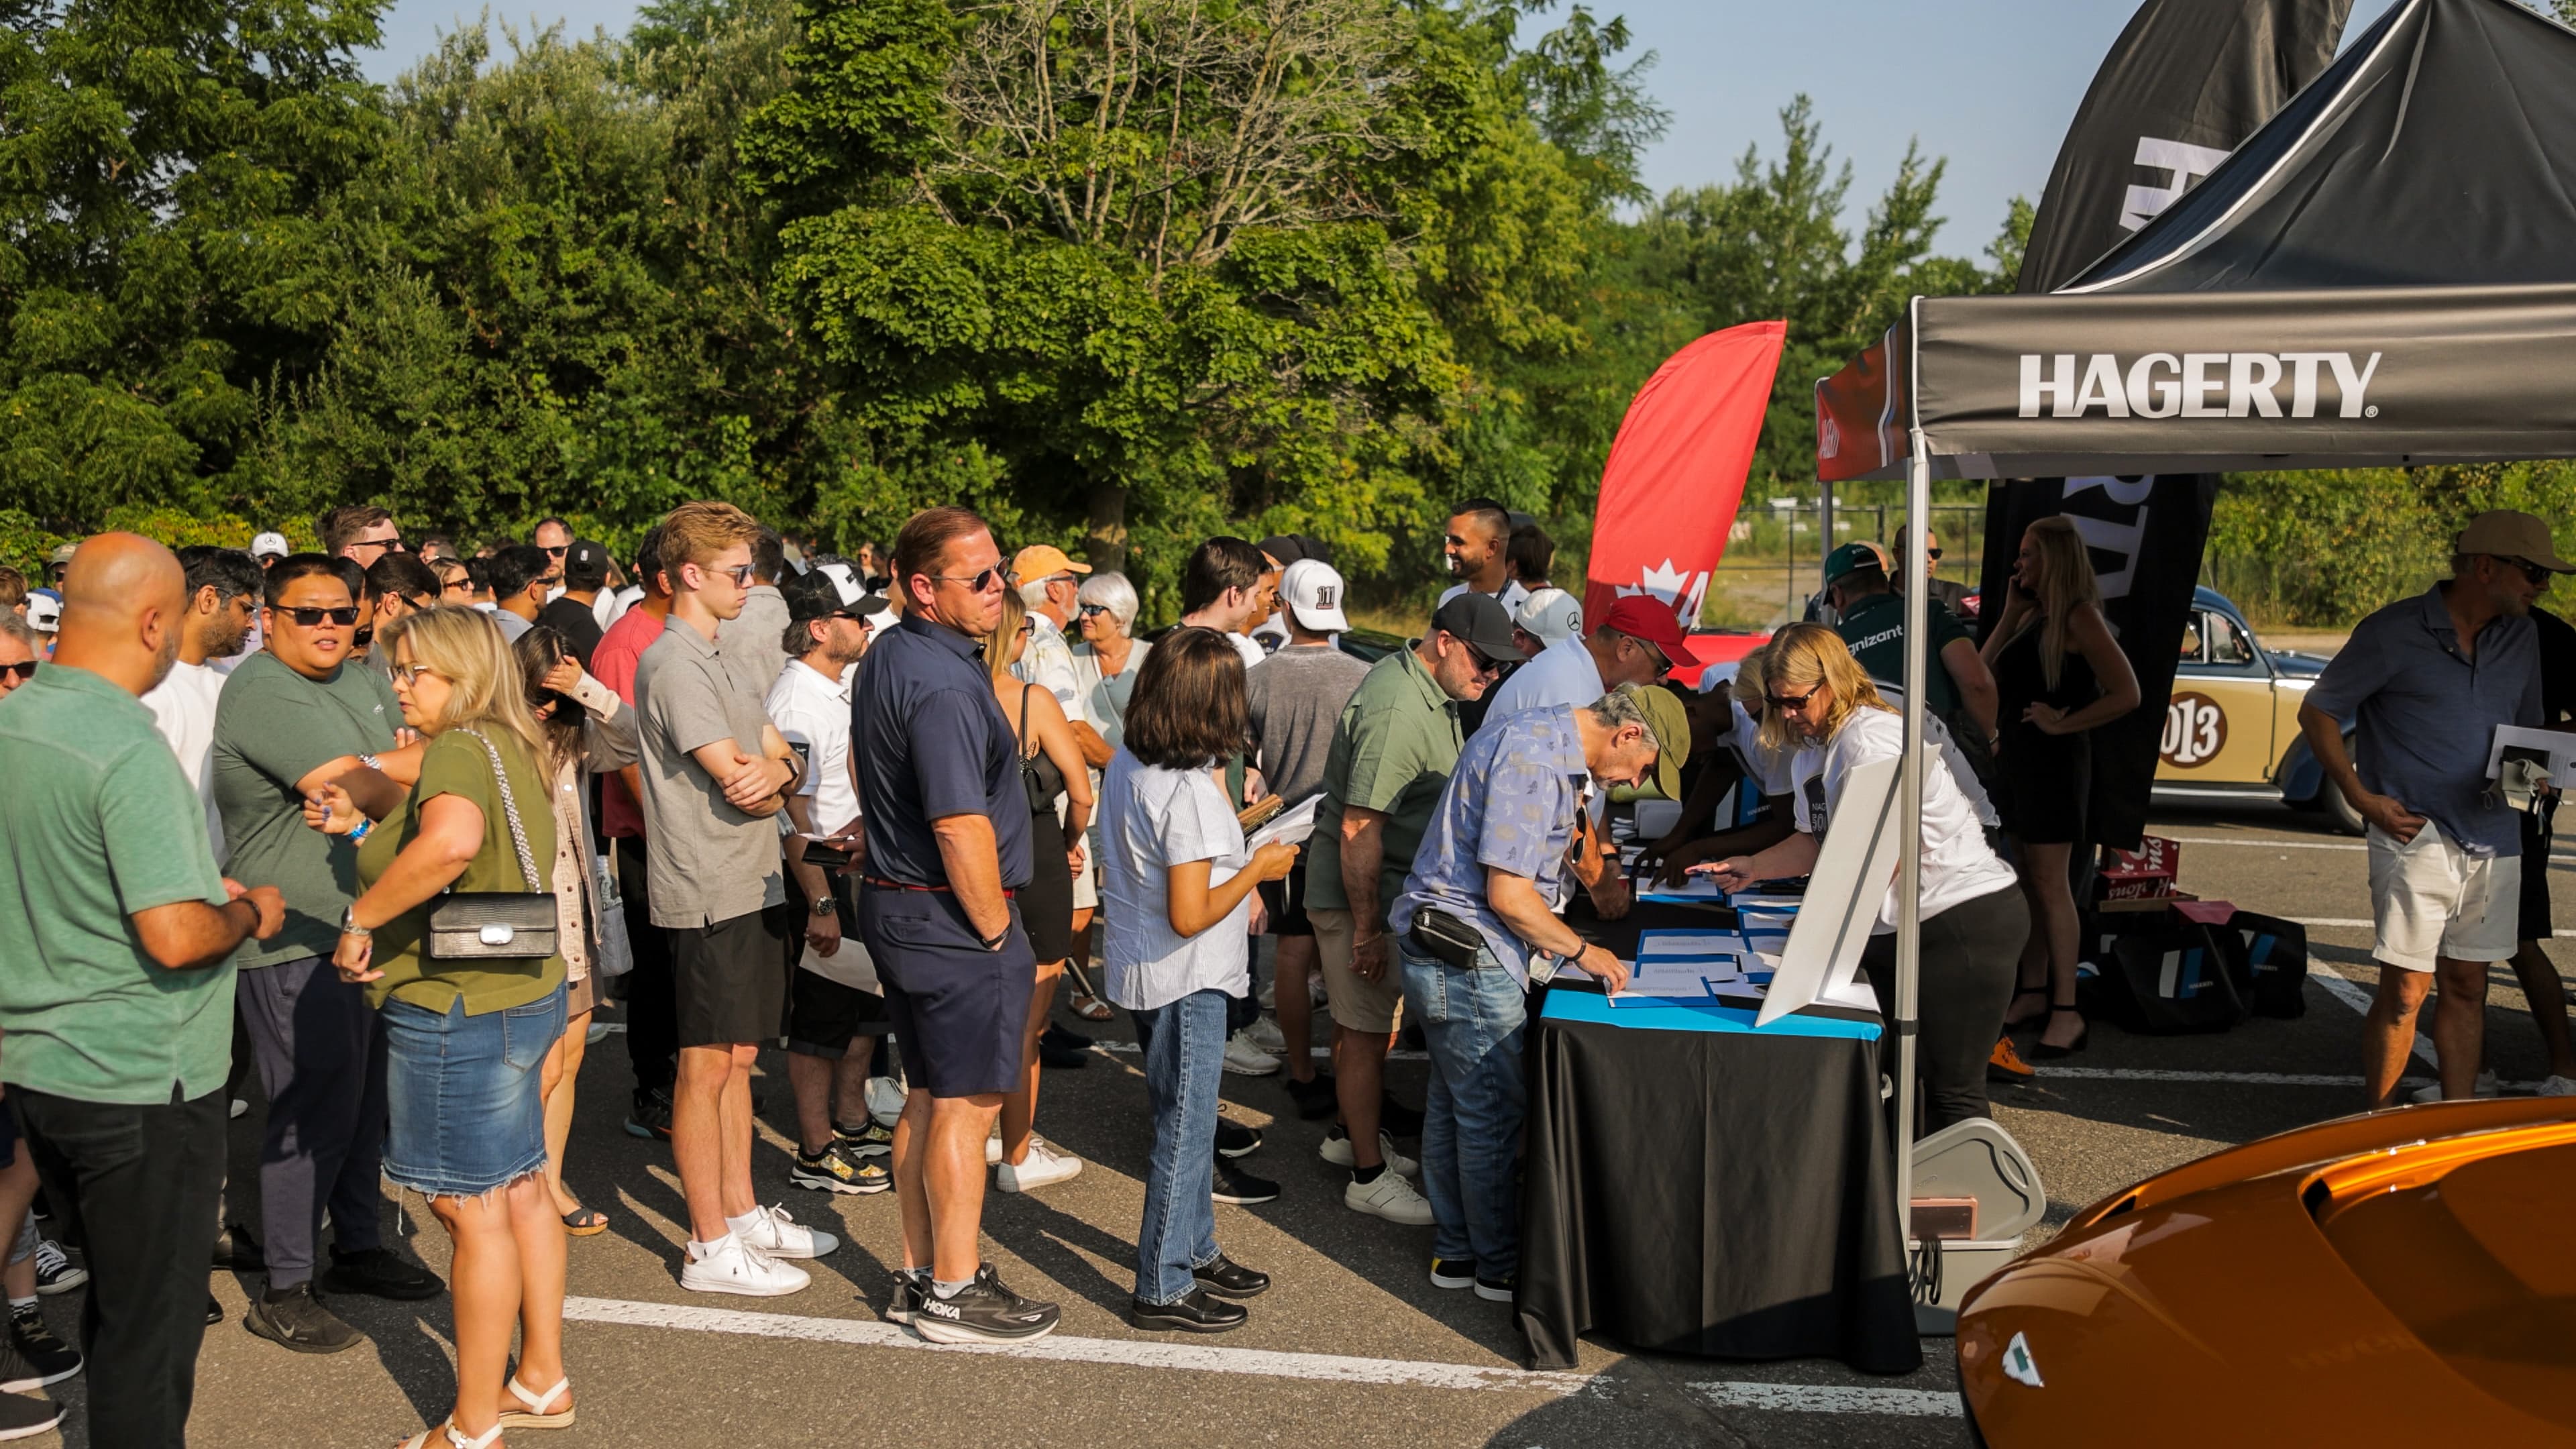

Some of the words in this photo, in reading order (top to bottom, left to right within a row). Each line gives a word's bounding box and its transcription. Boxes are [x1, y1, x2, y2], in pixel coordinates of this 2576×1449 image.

[2018, 352, 2381, 419] HAGERTY
[1847, 624, 1904, 657] gnizant
[2159, 698, 2219, 763] 013
[1812, 802, 1826, 812] NIAG
[923, 1297, 961, 1320] HOKA
